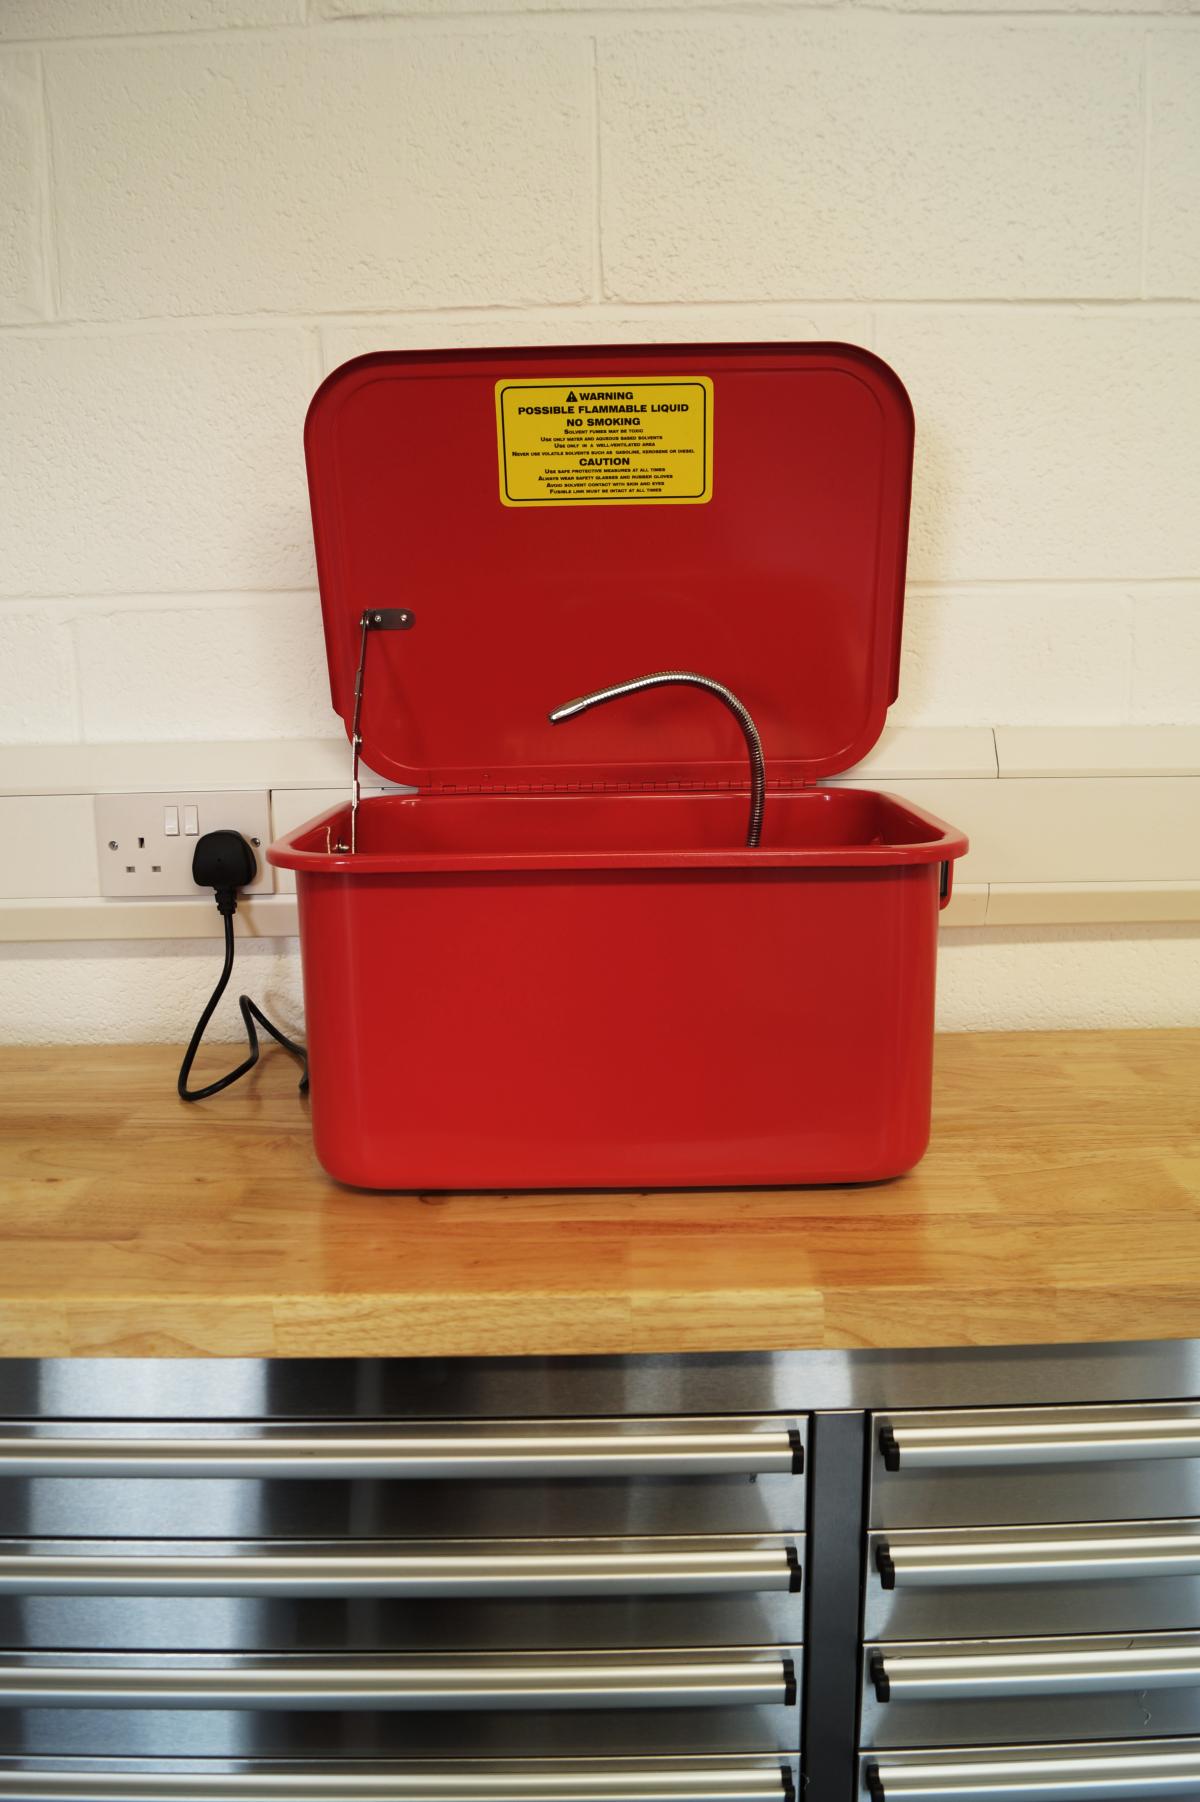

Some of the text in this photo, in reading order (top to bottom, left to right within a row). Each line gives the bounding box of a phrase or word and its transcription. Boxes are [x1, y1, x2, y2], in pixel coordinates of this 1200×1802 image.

[579, 392, 634, 400] WARNING
[518, 404, 689, 415] POSSIBLE FLAMMABLE LIQUID
[566, 418, 640, 427] NO SMOKING
[579, 458, 630, 466] CAUTION
